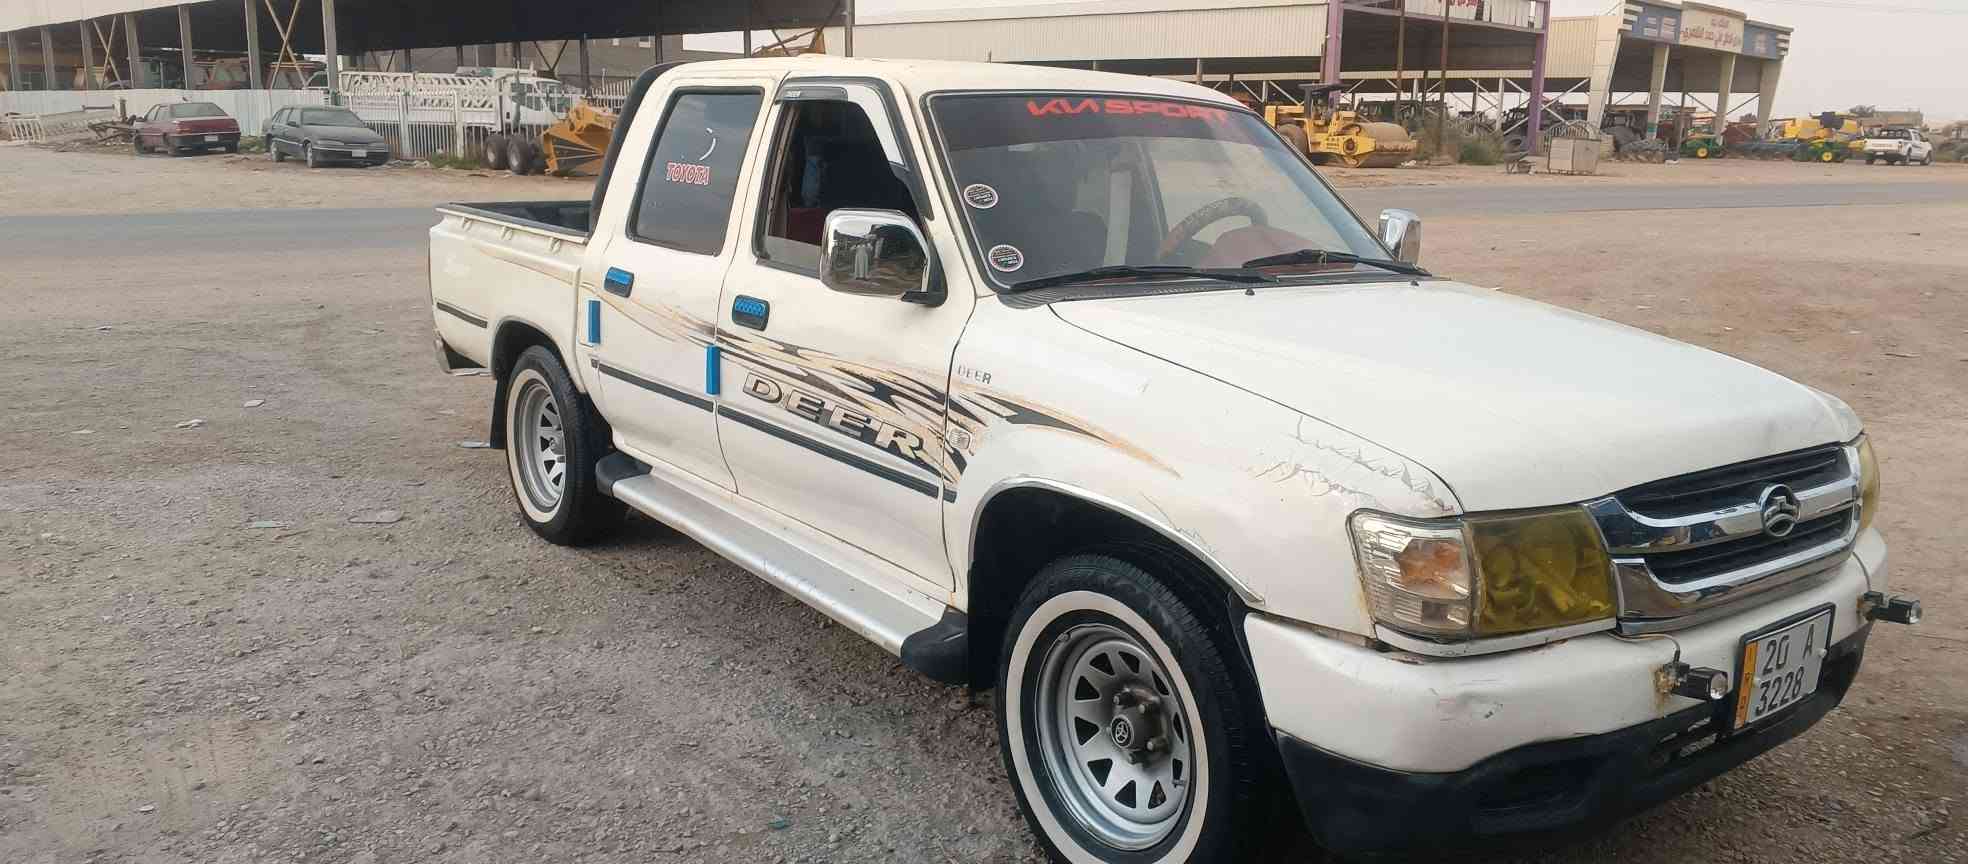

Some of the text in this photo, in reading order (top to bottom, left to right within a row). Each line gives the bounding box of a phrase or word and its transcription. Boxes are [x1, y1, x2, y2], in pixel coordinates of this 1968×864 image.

[666, 161, 710, 185] TOYOTA
[958, 364, 992, 384] DEER
[743, 371, 923, 459] DEER
[1762, 634, 1790, 676] 20
[1755, 665, 1805, 717] 3228
